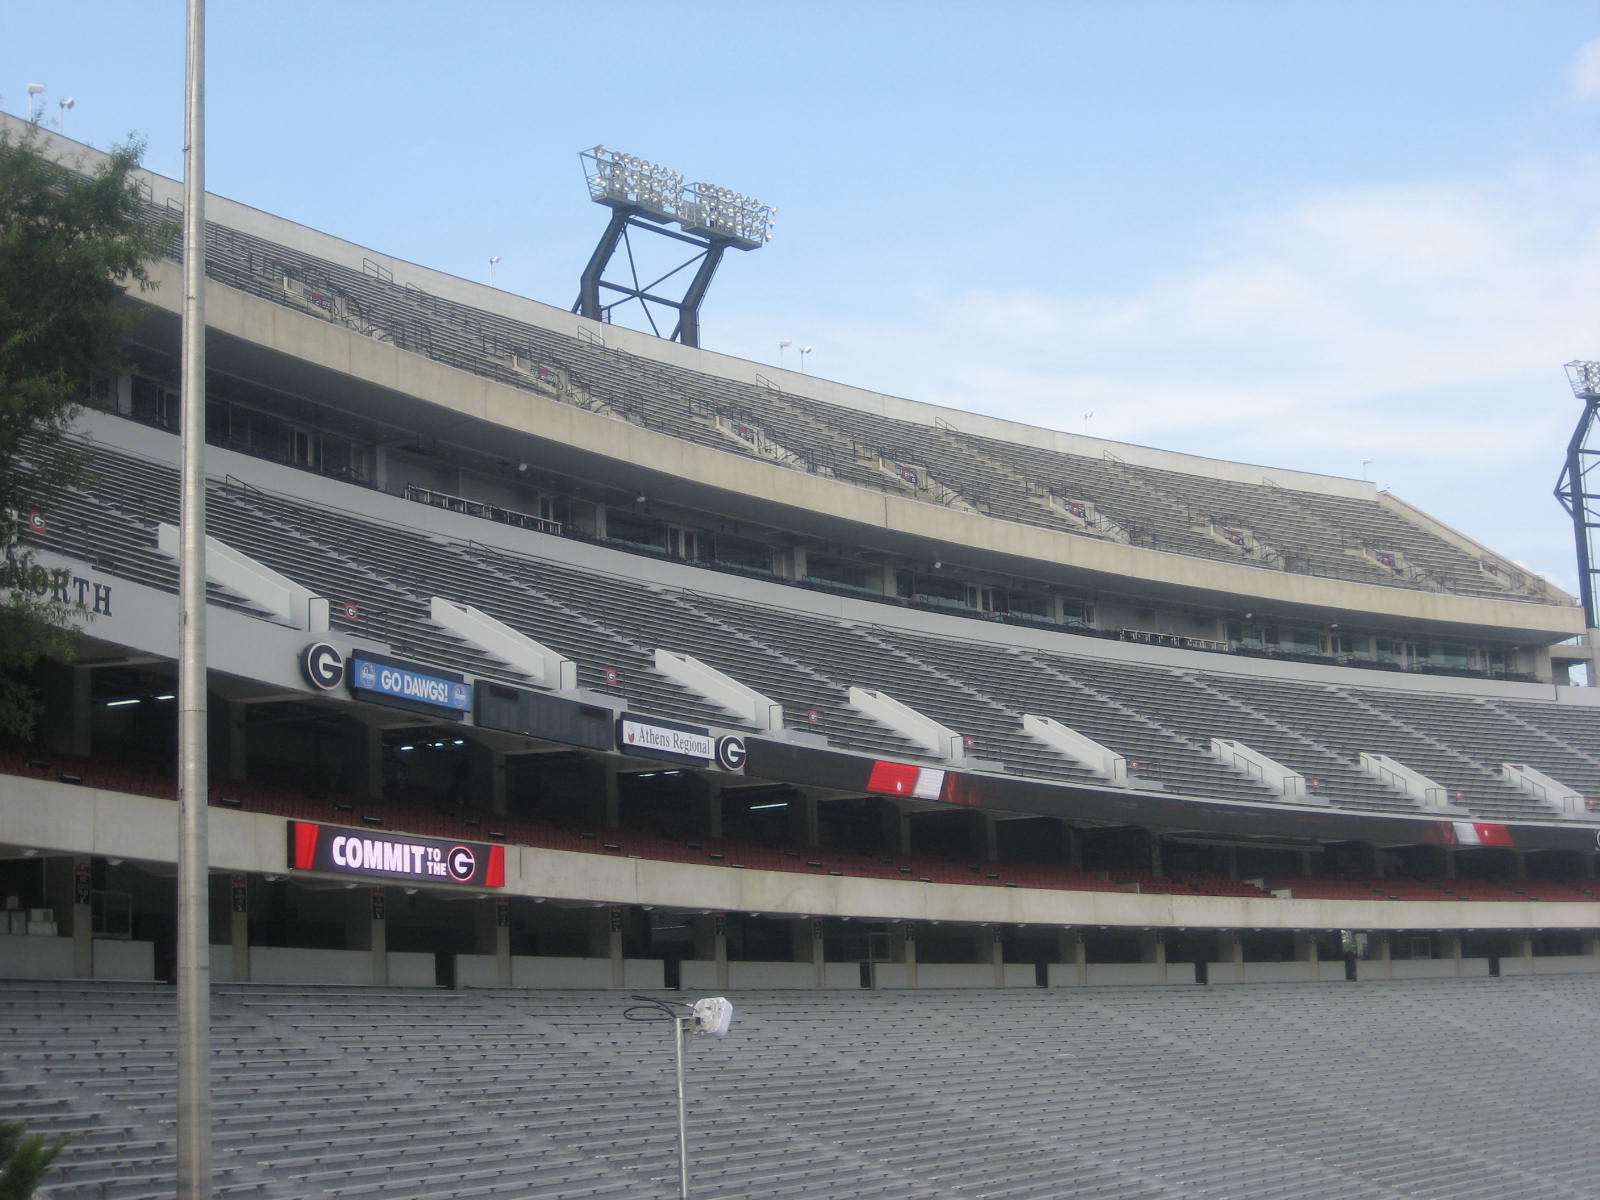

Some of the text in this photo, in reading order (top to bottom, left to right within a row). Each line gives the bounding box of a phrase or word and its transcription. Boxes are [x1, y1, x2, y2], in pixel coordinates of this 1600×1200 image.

[308, 642, 344, 690] G
[381, 670, 448, 703] GO DAWGS!
[639, 727, 710, 754] Athens Regional
[720, 735, 746, 771] G
[332, 836, 475, 881] COMMIT TO THE G
